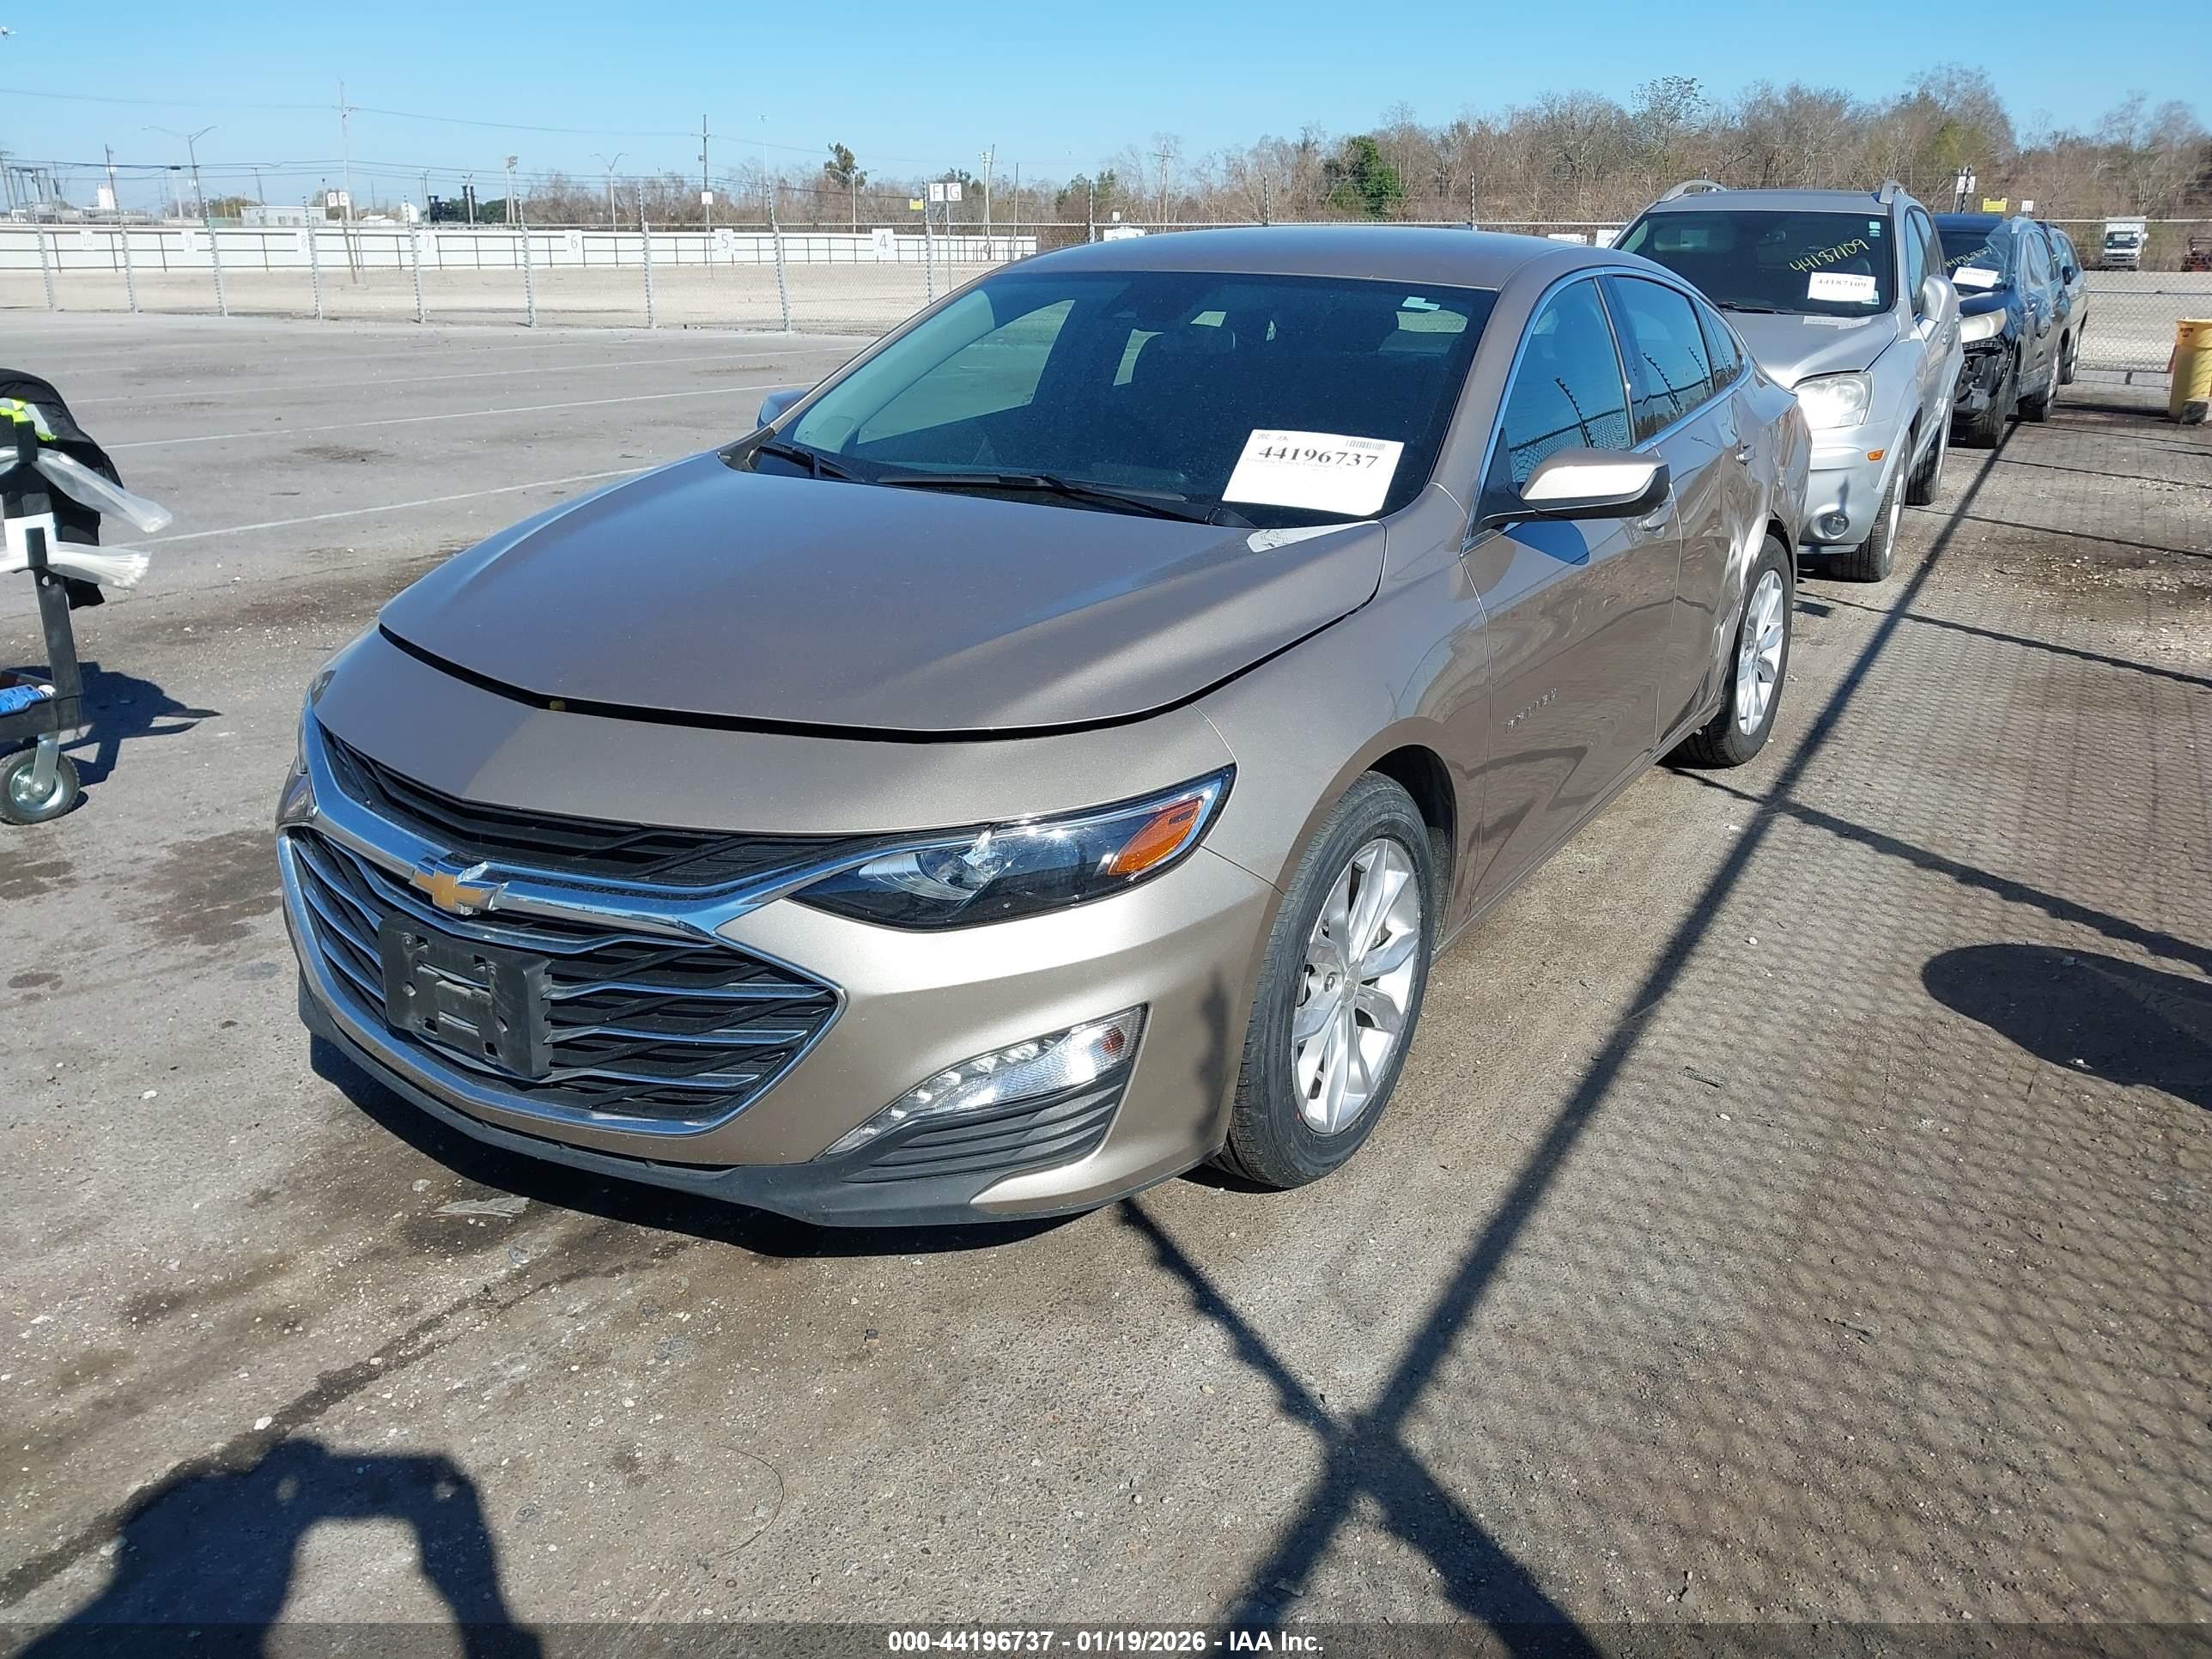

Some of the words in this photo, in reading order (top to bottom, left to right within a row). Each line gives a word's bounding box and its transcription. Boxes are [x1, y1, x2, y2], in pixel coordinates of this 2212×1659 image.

[933, 185, 940, 199] F
[949, 185, 959, 199] G
[185, 234, 192, 247] 9
[301, 234, 307, 247] 8
[425, 234, 431, 247] 7
[570, 234, 578, 249] 6
[721, 234, 729, 249] 5
[878, 234, 888, 250] 4
[1790, 238, 1870, 273] 44187109
[1258, 446, 1380, 469] 44196737
